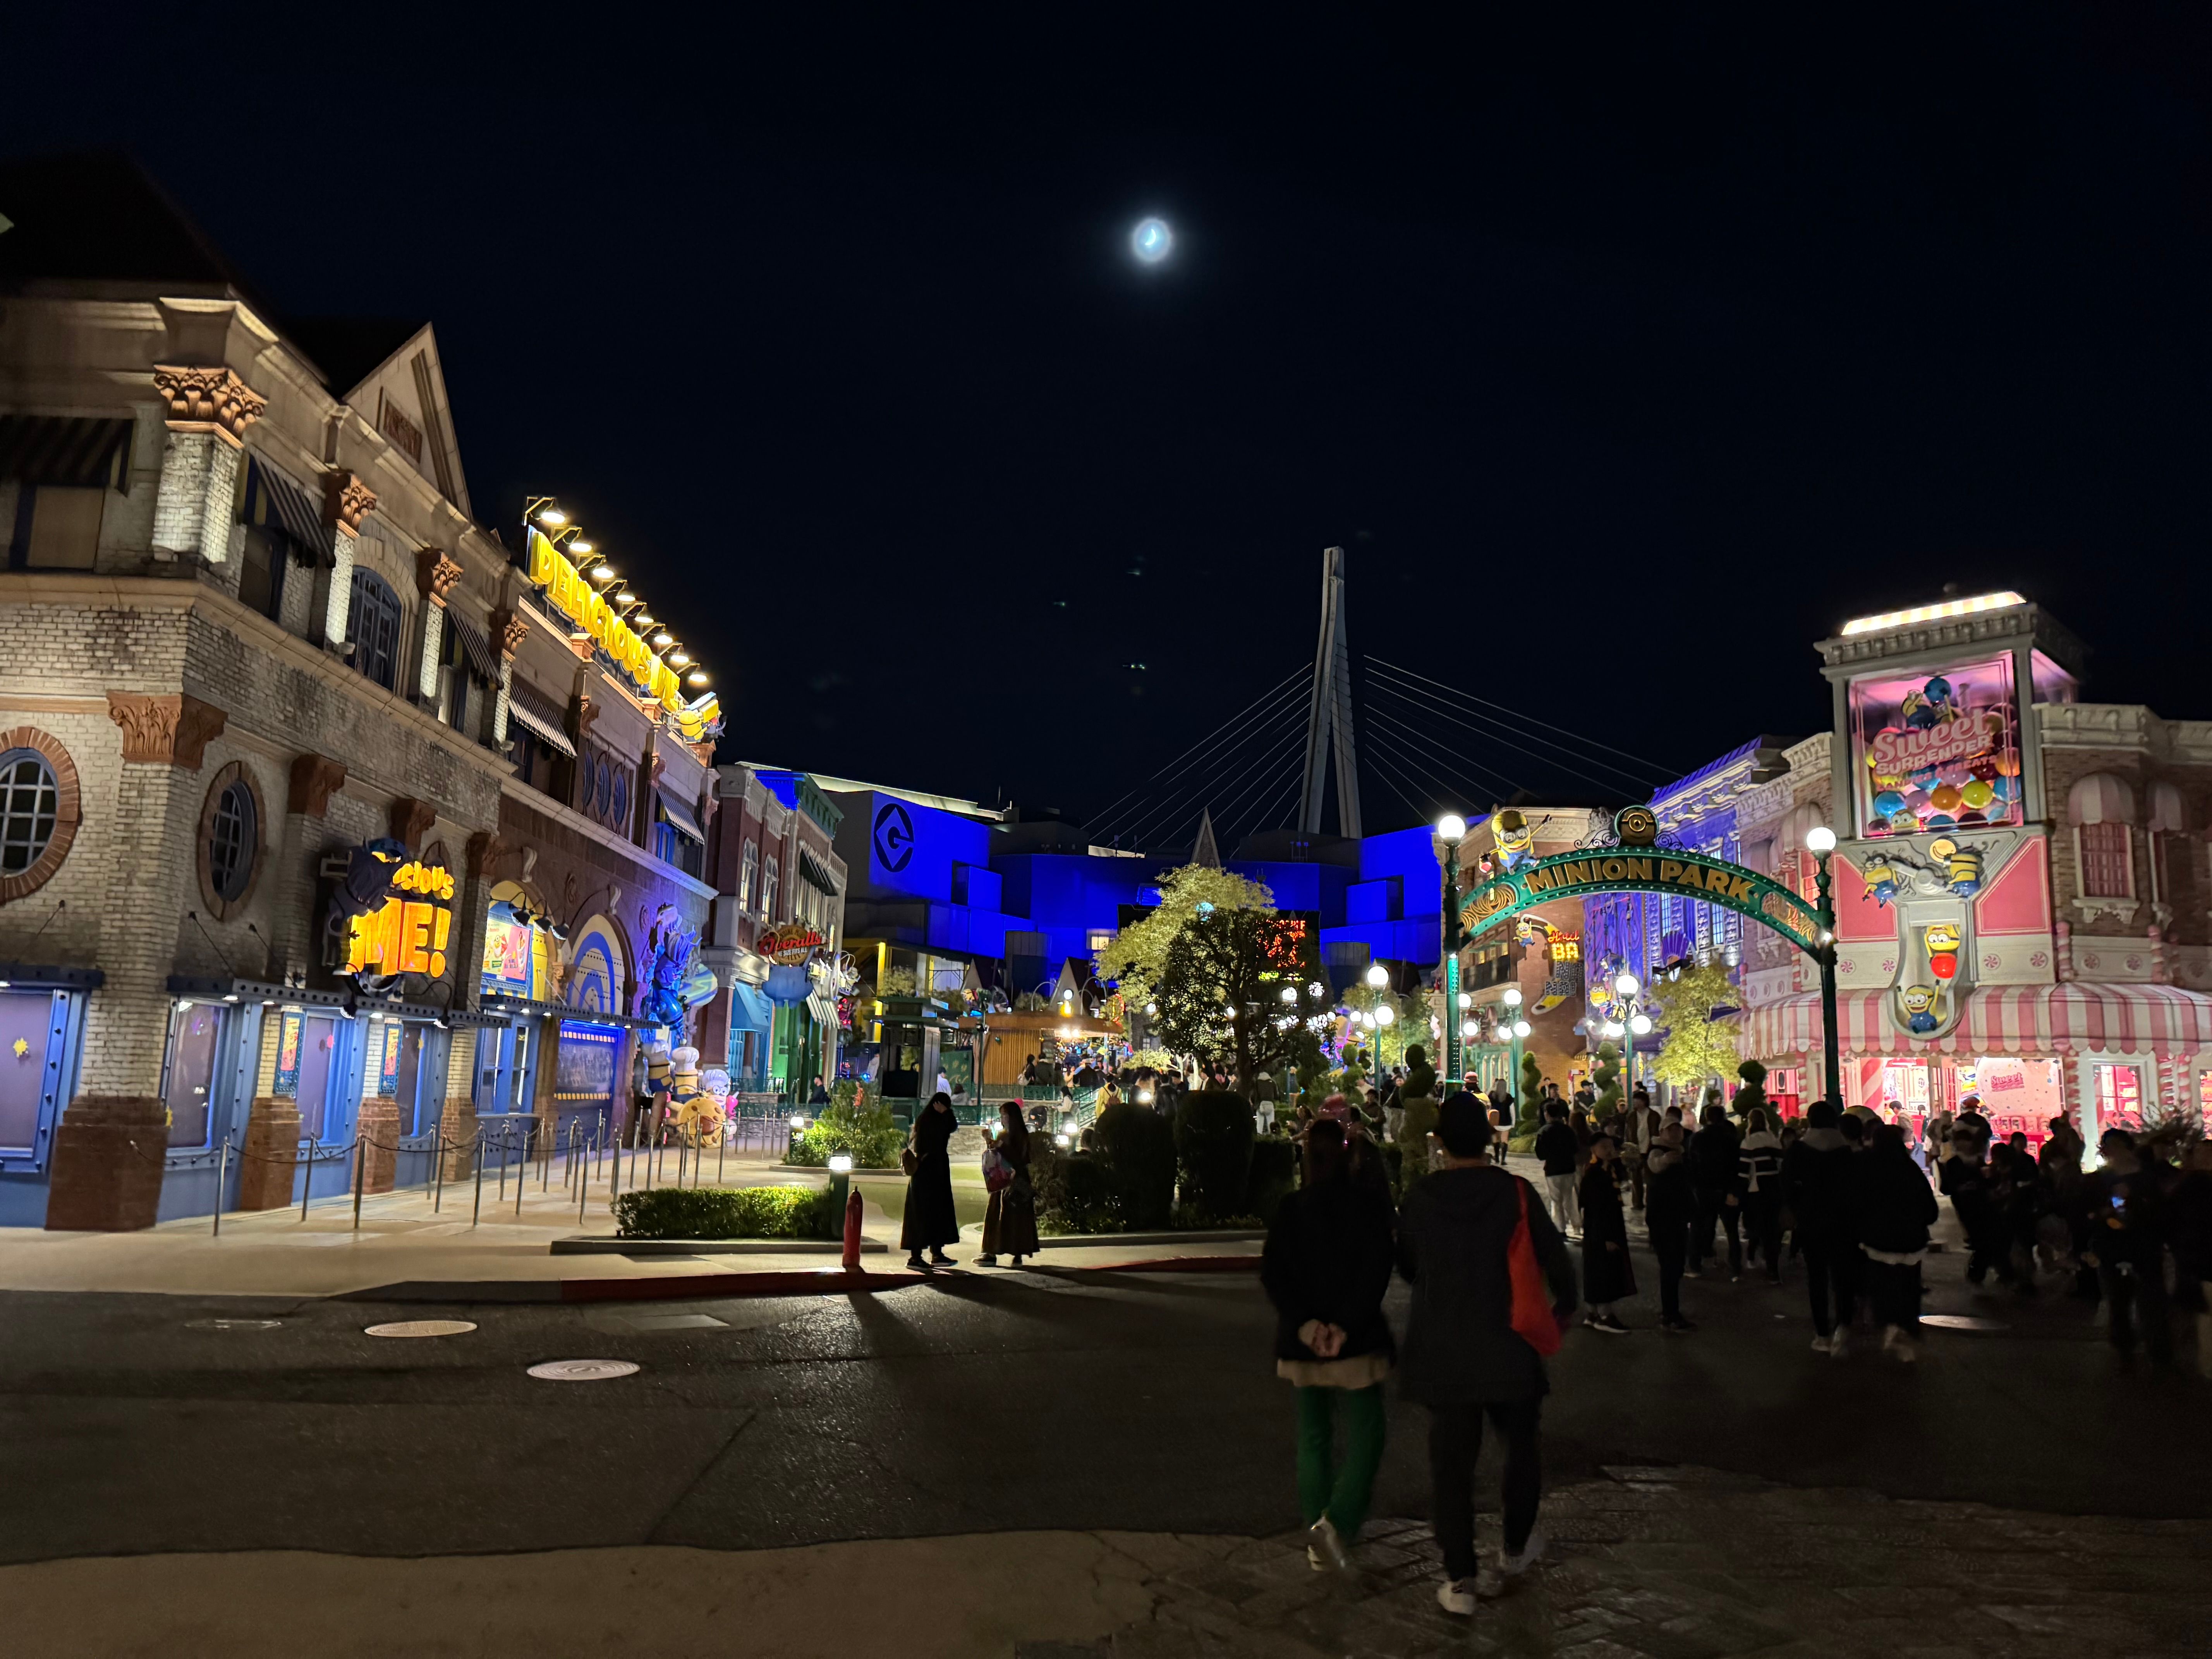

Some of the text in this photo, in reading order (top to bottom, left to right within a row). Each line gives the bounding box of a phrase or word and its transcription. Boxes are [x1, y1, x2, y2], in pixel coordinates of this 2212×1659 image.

[530, 530, 652, 685] DELICIOUS
[1875, 708, 1992, 762] Sweet
[1876, 735, 1991, 775] SURRENDER
[1525, 858, 1756, 903] MINION PARK
[346, 895, 452, 977] ME!
